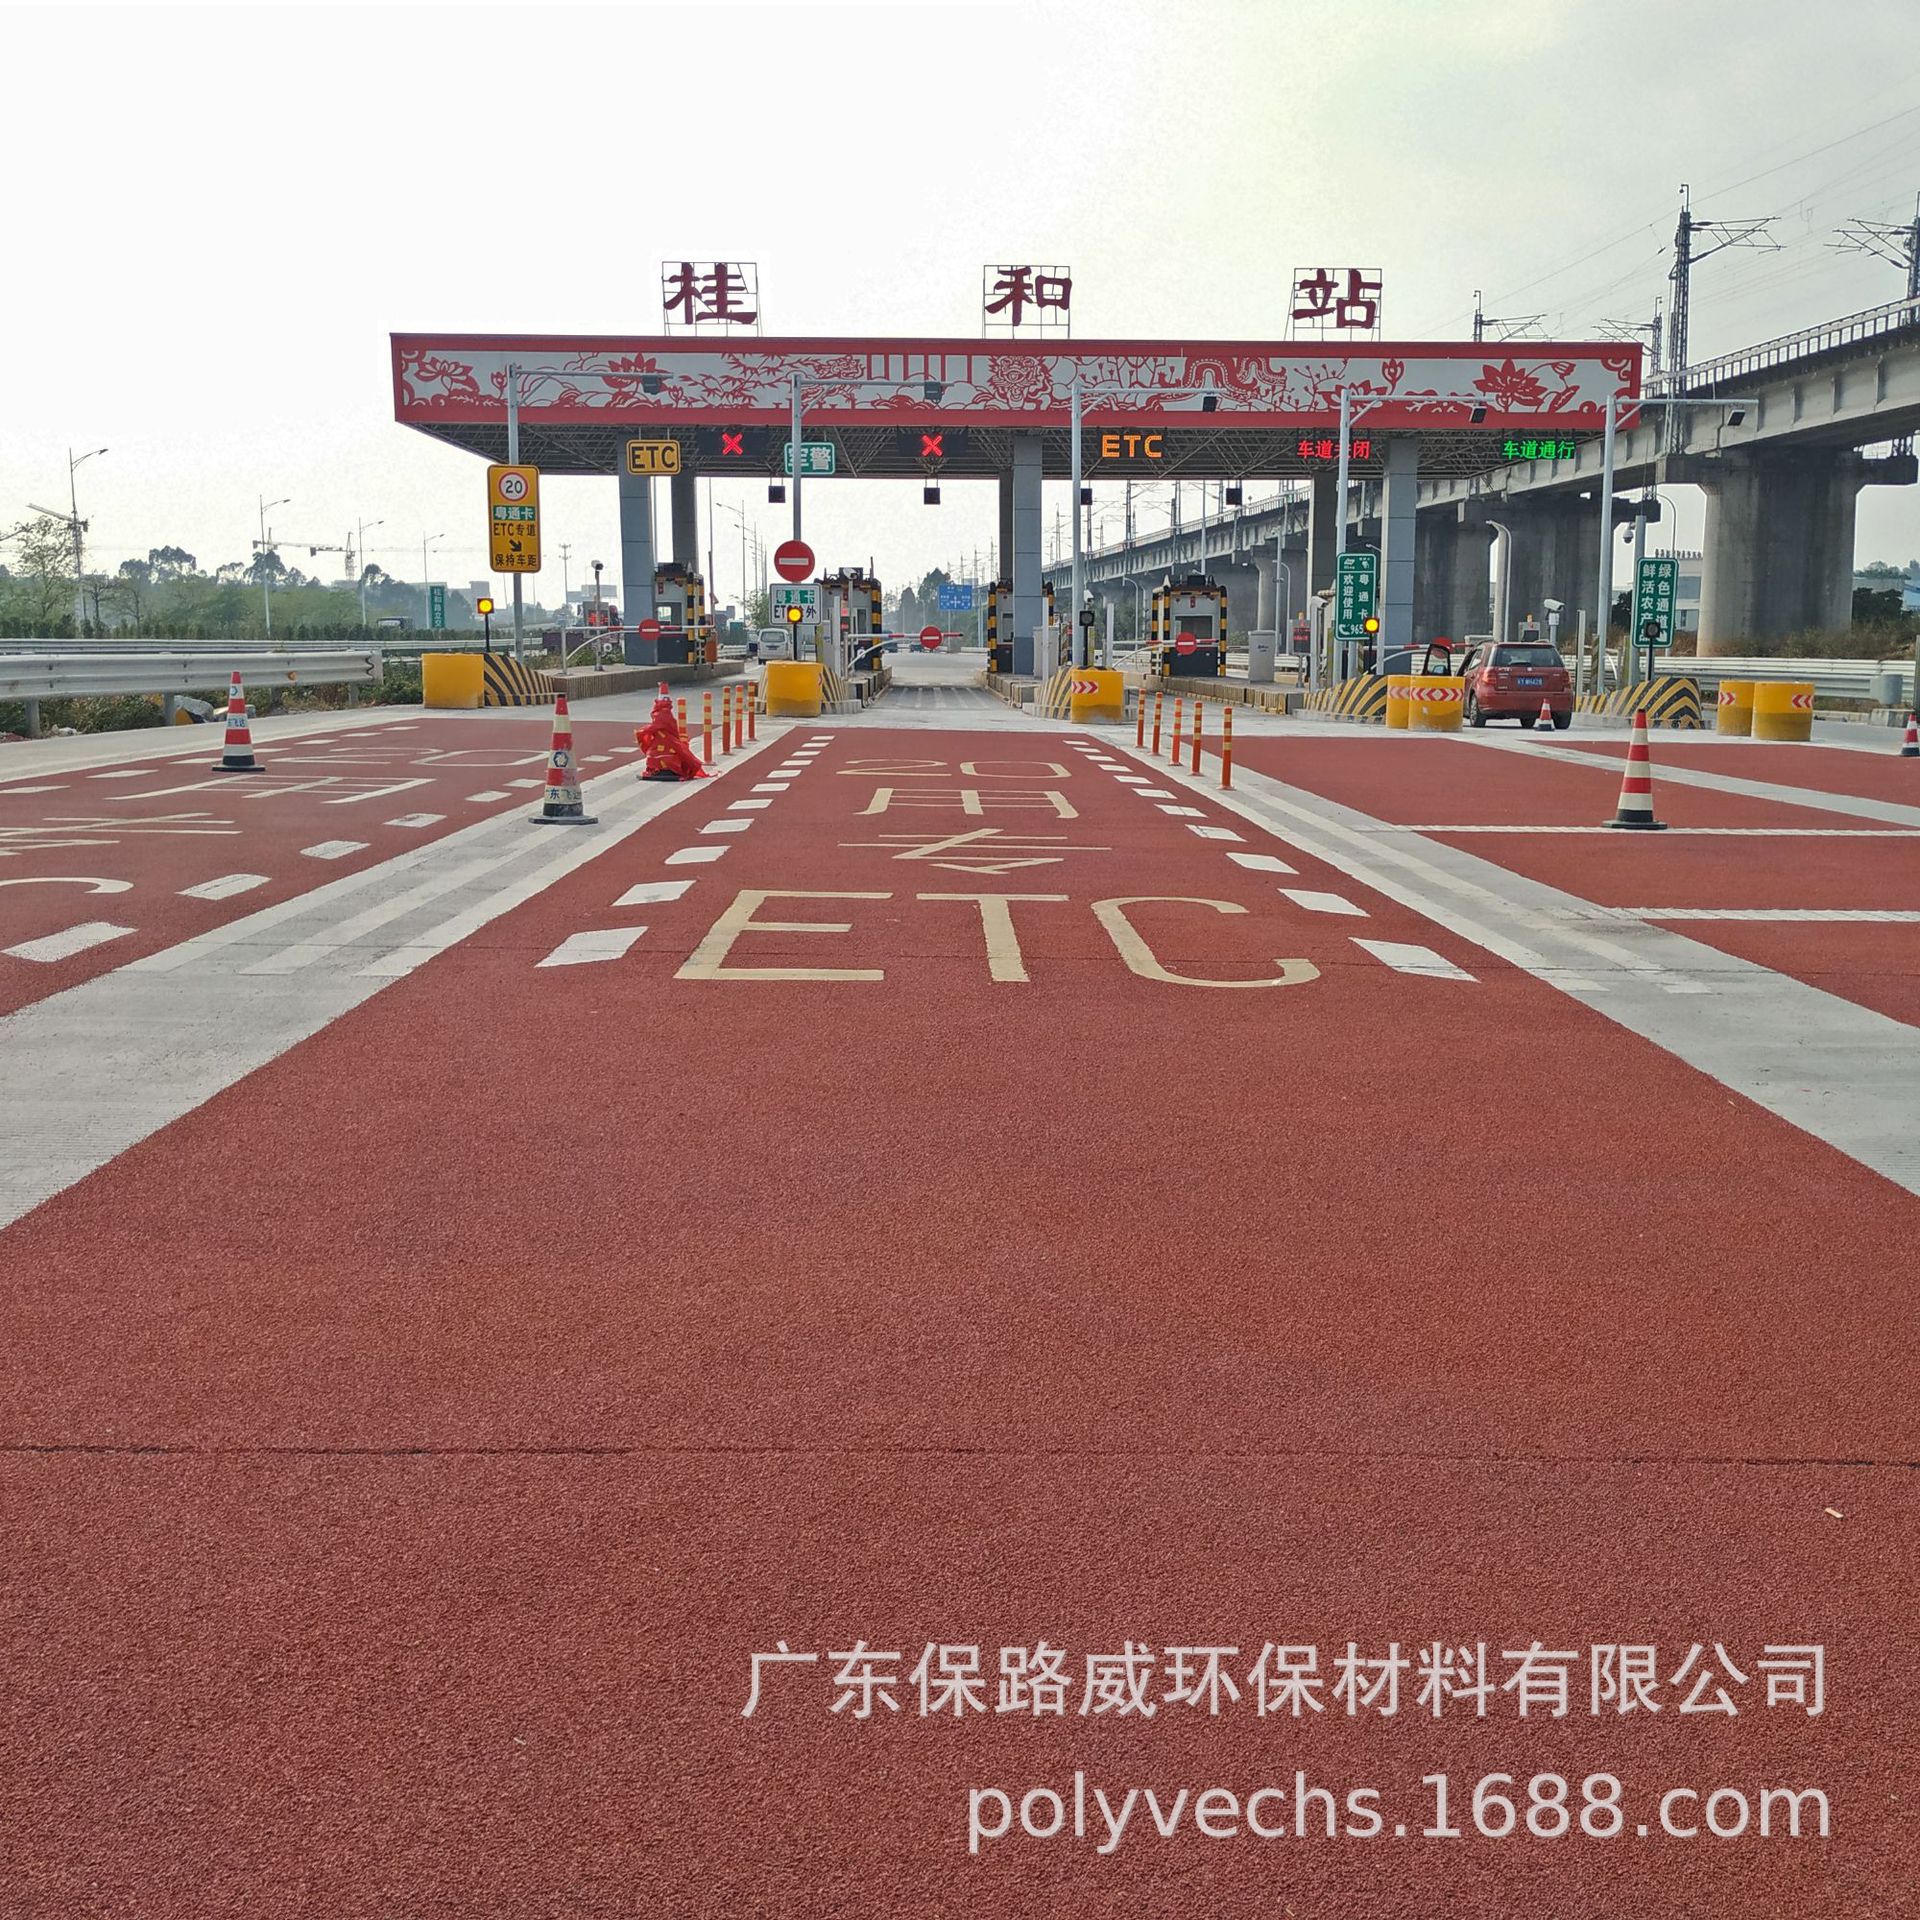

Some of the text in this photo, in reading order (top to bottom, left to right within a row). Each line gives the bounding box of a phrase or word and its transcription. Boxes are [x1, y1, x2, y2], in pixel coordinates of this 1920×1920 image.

[663, 262, 1383, 328] 桂和站
[631, 445, 676, 469] ETC
[1102, 434, 1163, 458] ETC
[1502, 440, 1576, 460] 车道通行
[505, 480, 523, 494] 20
[494, 506, 535, 520] 粤通卡
[495, 554, 537, 567] 保持车距
[1342, 573, 1354, 620] 欢迎使用
[1357, 573, 1370, 619] 粤通卡
[1656, 563, 1672, 630] 绿色通道
[774, 605, 817, 619] ET外
[837, 759, 1073, 779] 20
[673, 889, 1322, 987] ETC
